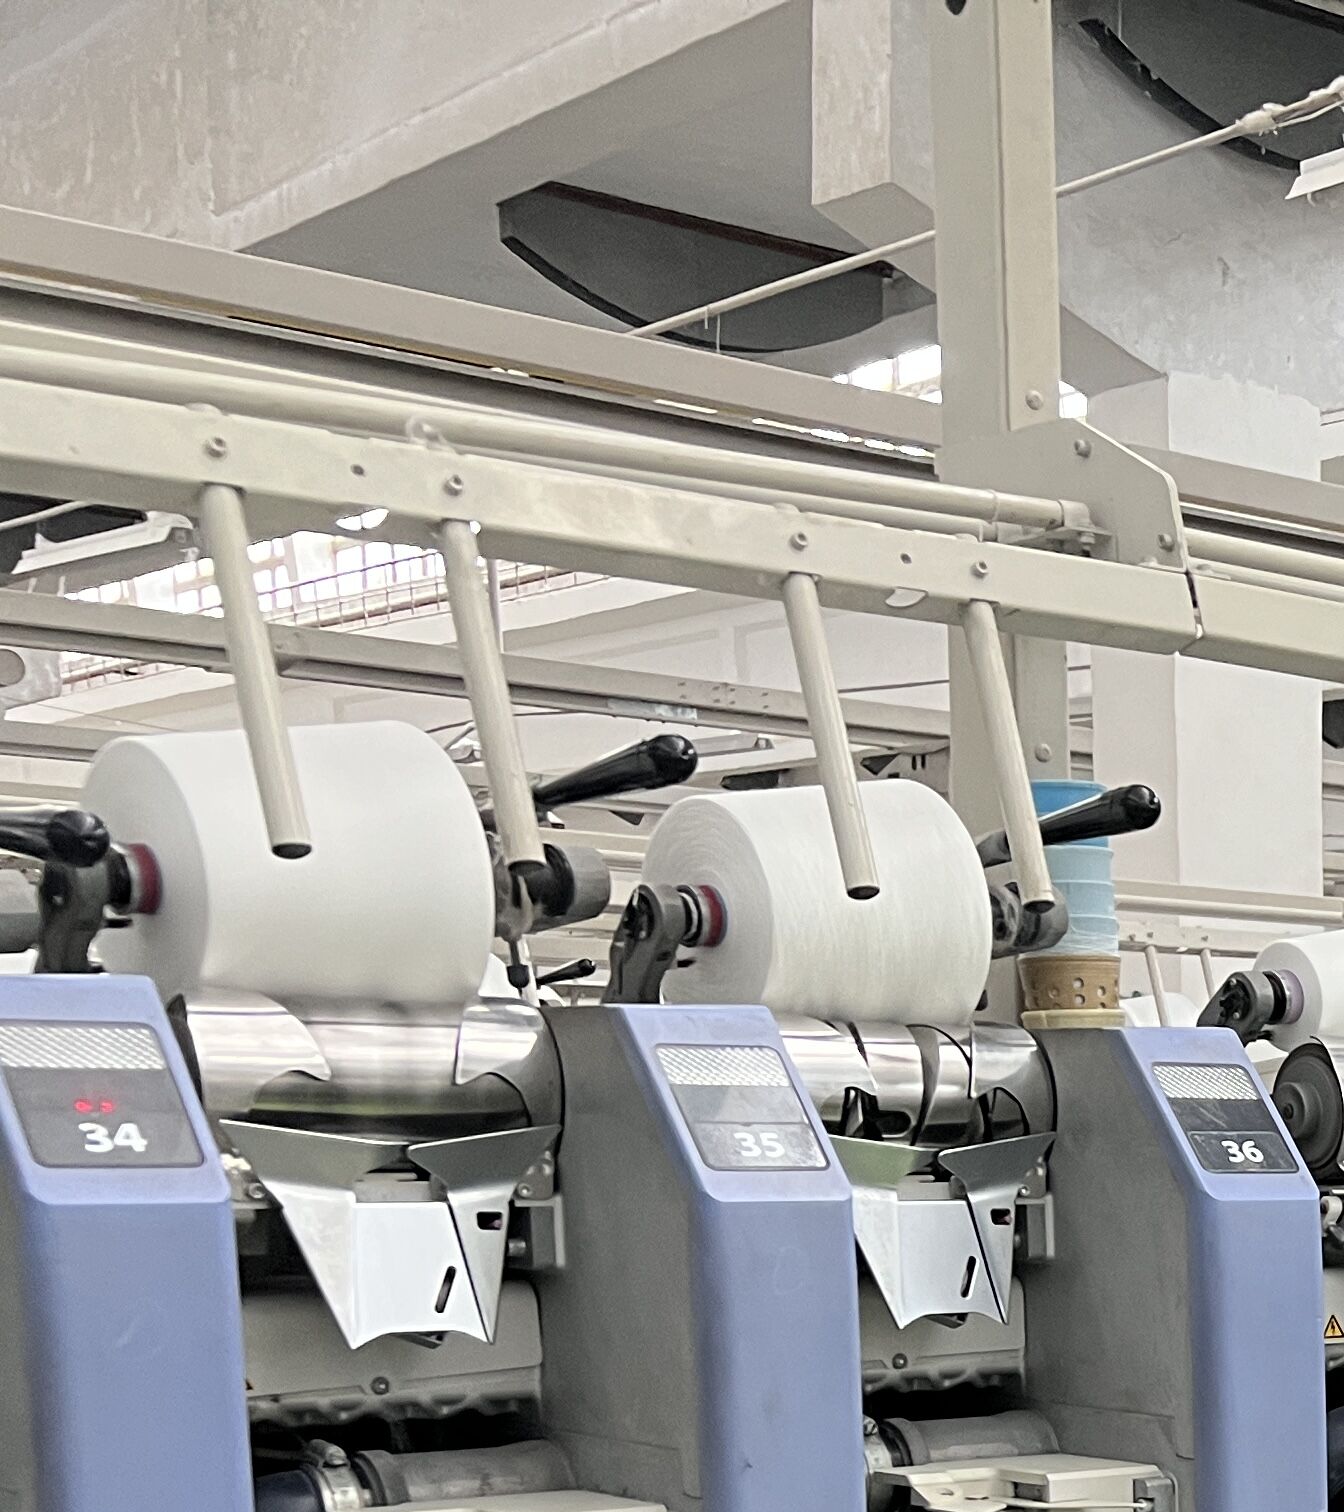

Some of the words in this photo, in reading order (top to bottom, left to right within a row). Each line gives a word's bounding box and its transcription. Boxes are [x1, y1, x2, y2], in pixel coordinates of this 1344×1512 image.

[77, 1121, 148, 1153] 34
[733, 1131, 787, 1159] 35
[1220, 1139, 1265, 1164] 36
